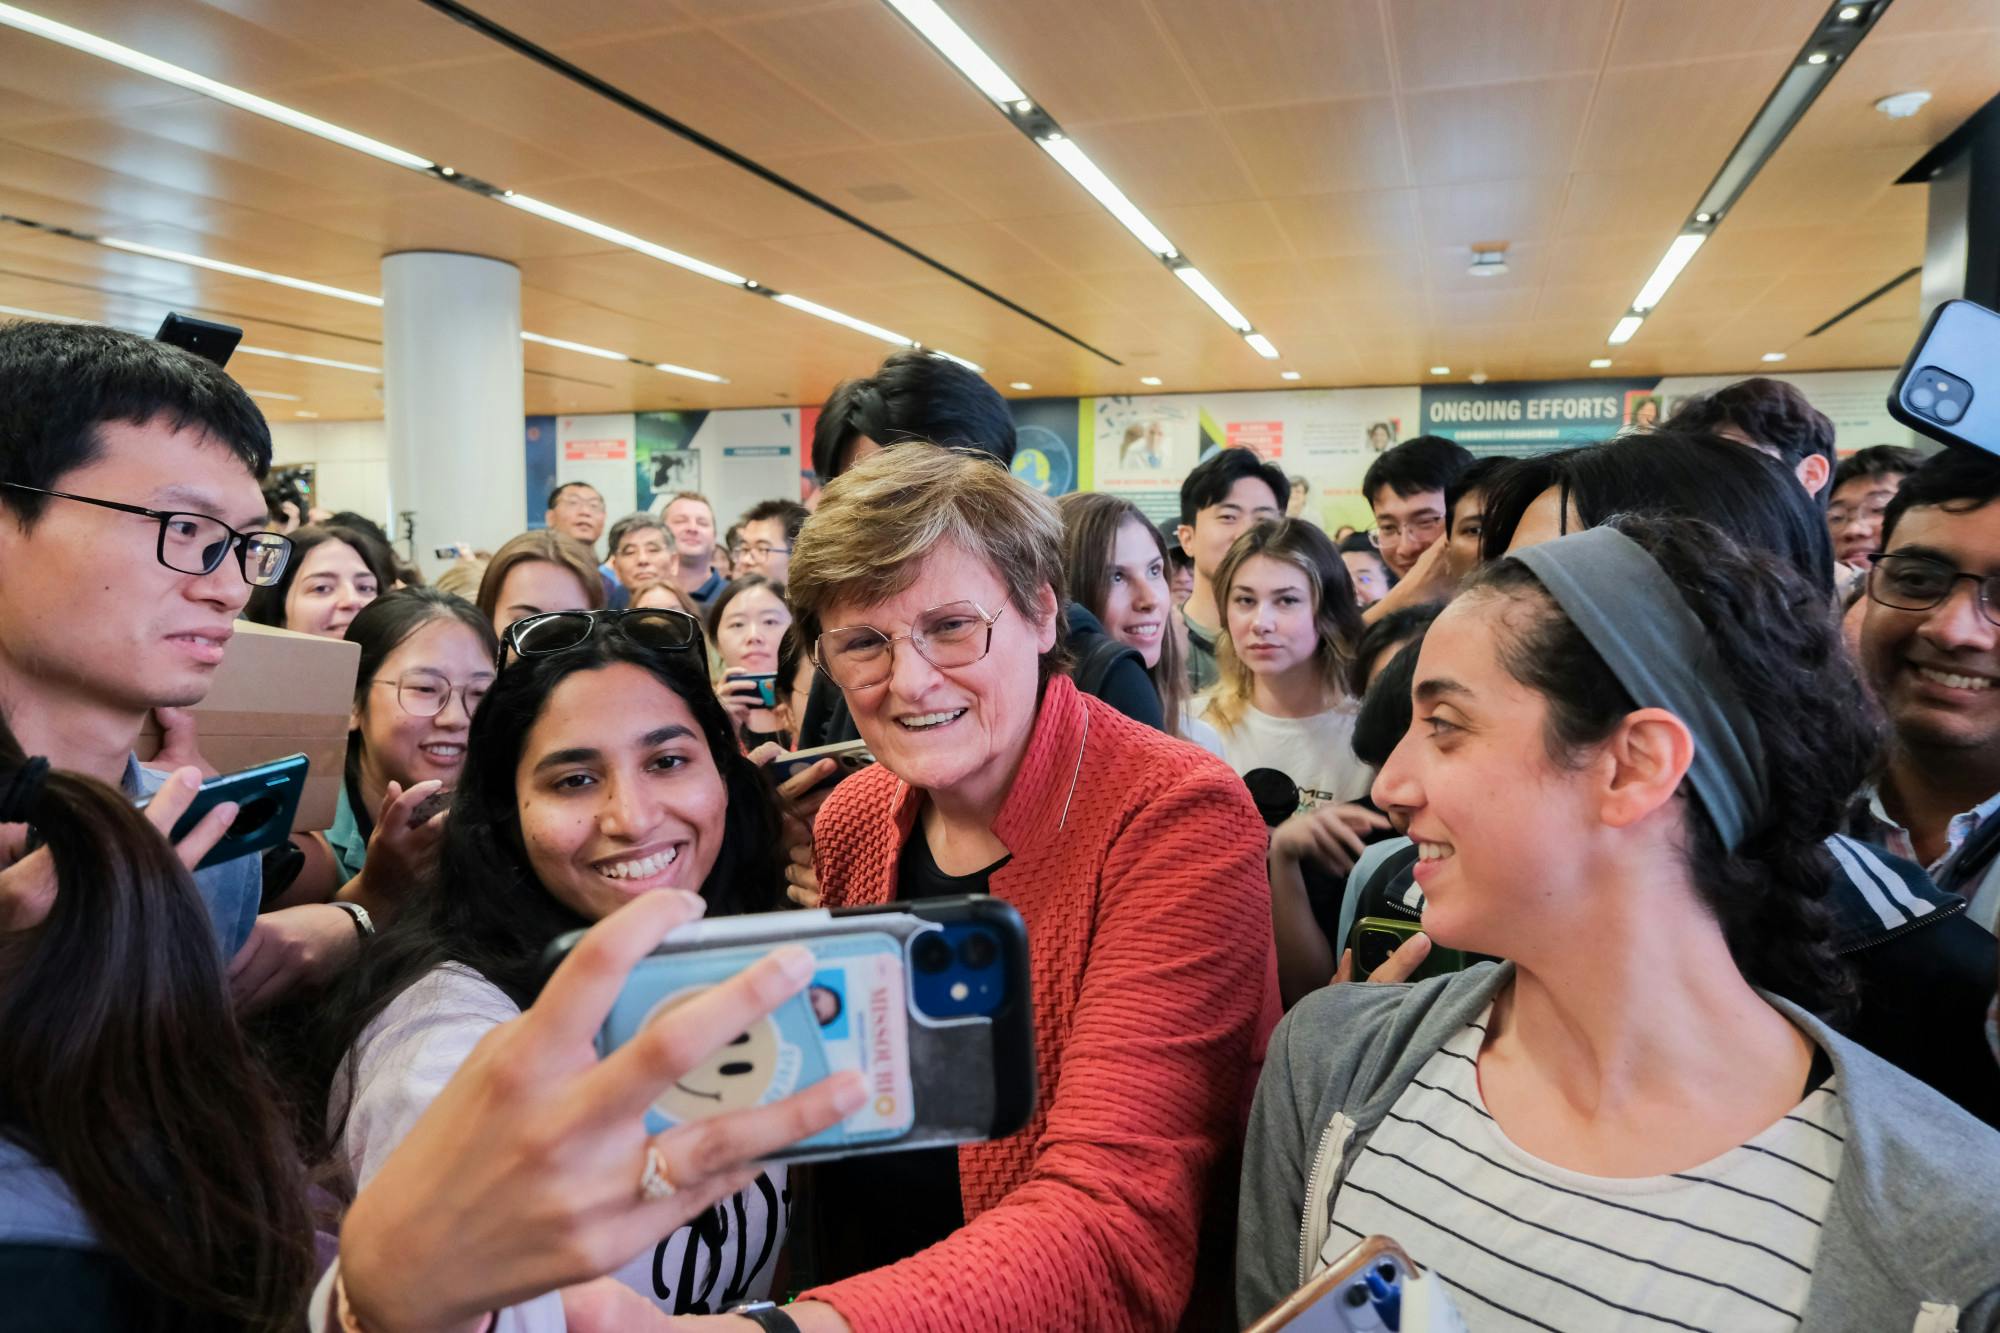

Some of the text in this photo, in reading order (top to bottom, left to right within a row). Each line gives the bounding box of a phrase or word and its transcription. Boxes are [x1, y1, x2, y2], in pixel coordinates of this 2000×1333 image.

[1429, 397, 1618, 422] ONGOING EFFORTS
[871, 986, 895, 1095] MISSOURI
